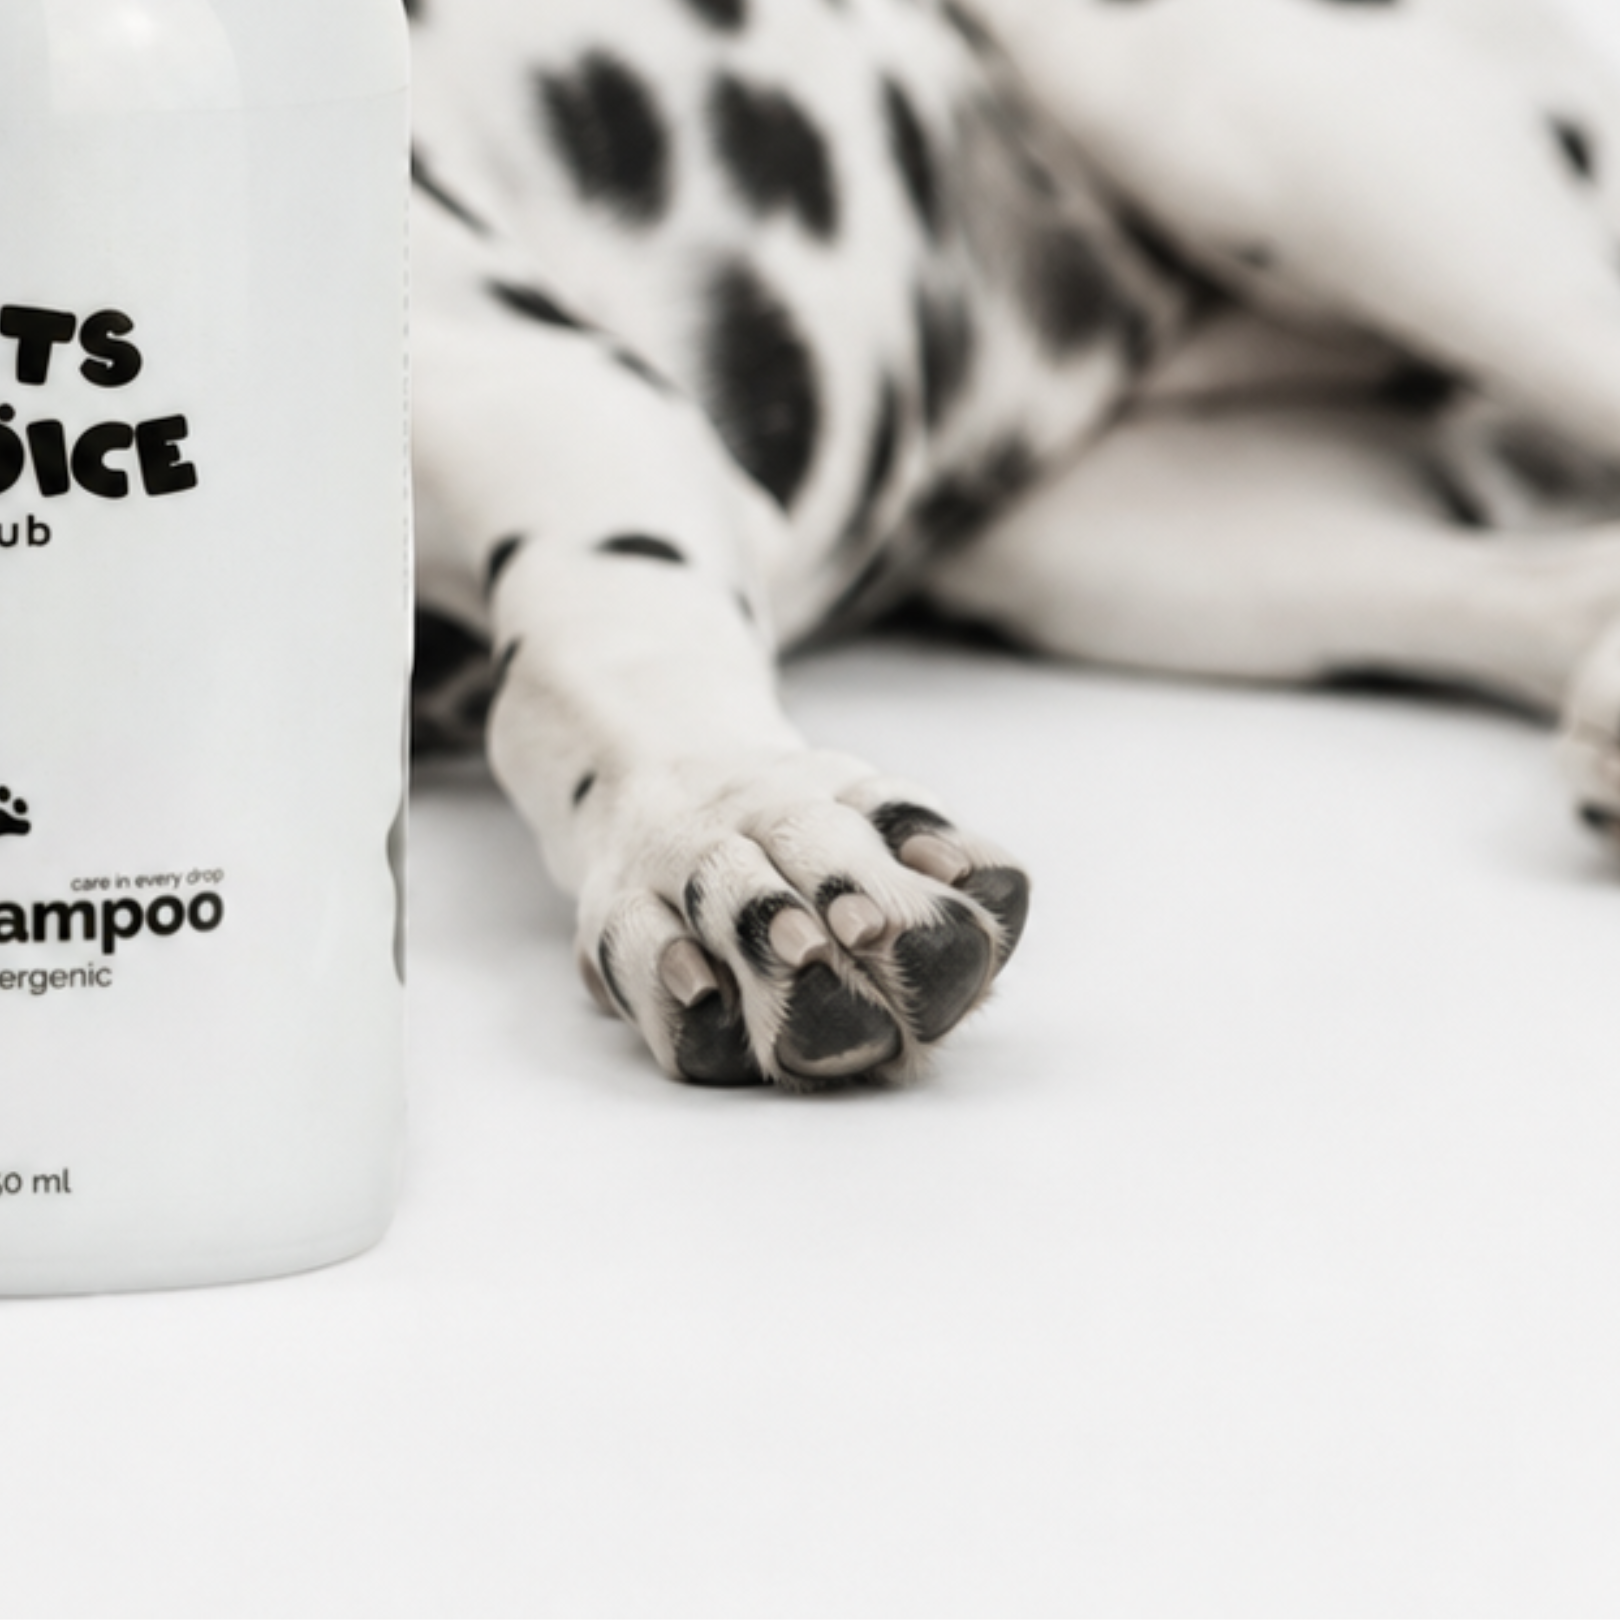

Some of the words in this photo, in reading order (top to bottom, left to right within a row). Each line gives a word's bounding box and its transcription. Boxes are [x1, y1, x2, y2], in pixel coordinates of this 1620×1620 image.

[70, 876, 111, 892] care
[115, 873, 131, 889] in
[135, 872, 182, 890] every
[186, 867, 225, 886] drop
[32, 1168, 72, 1194] ml
